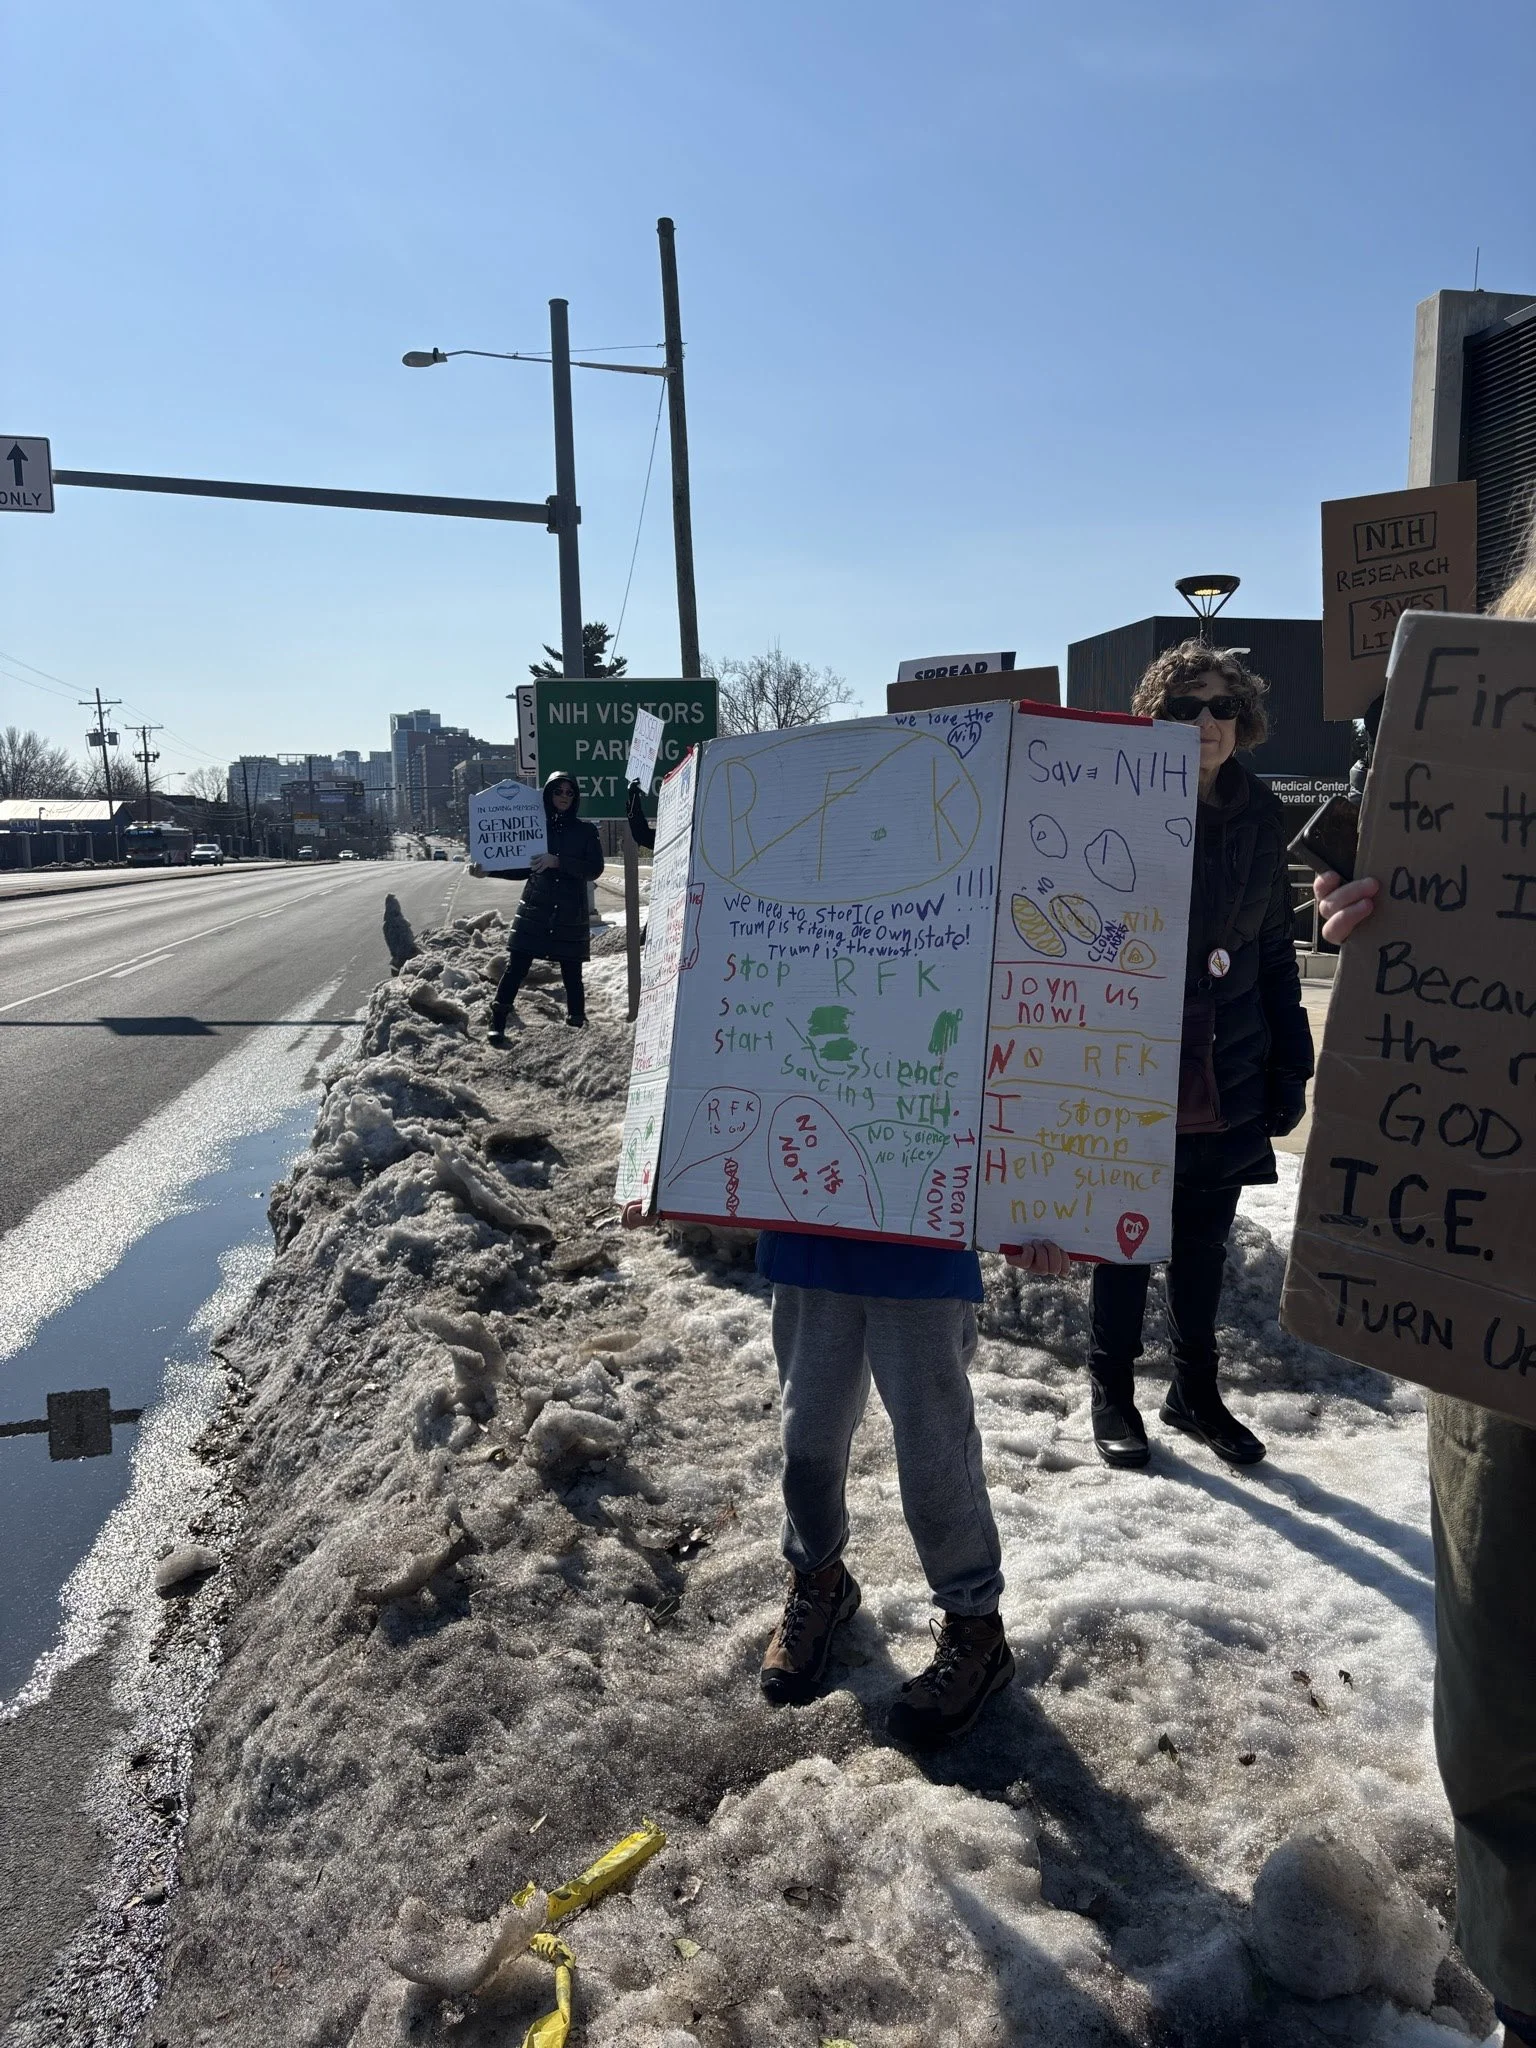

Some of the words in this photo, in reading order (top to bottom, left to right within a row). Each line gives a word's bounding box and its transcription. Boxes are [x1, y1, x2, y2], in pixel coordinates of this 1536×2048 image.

[0, 491, 42, 506] ONLY
[1365, 518, 1427, 550] NIH
[1336, 557, 1450, 592] RESEARCH
[549, 702, 588, 725] NIH
[928, 712, 957, 727] love
[964, 708, 994, 724] the
[1115, 749, 1188, 798] NIH
[1271, 781, 1312, 792] Medical
[1314, 781, 1349, 792] Center
[1389, 763, 1454, 833] for
[477, 828, 543, 845] AFFIRMING
[478, 815, 540, 832] GENDER
[484, 845, 527, 860] CARE
[1389, 865, 1468, 912] and
[788, 905, 806, 921] to
[1105, 983, 1139, 1010] us
[1364, 1013, 1468, 1074] the
[1379, 1082, 1522, 1159] GOD
[948, 1164, 973, 1238] mean
[1319, 1157, 1494, 1262] I.C.E.
[1317, 1272, 1454, 1350] TURN
